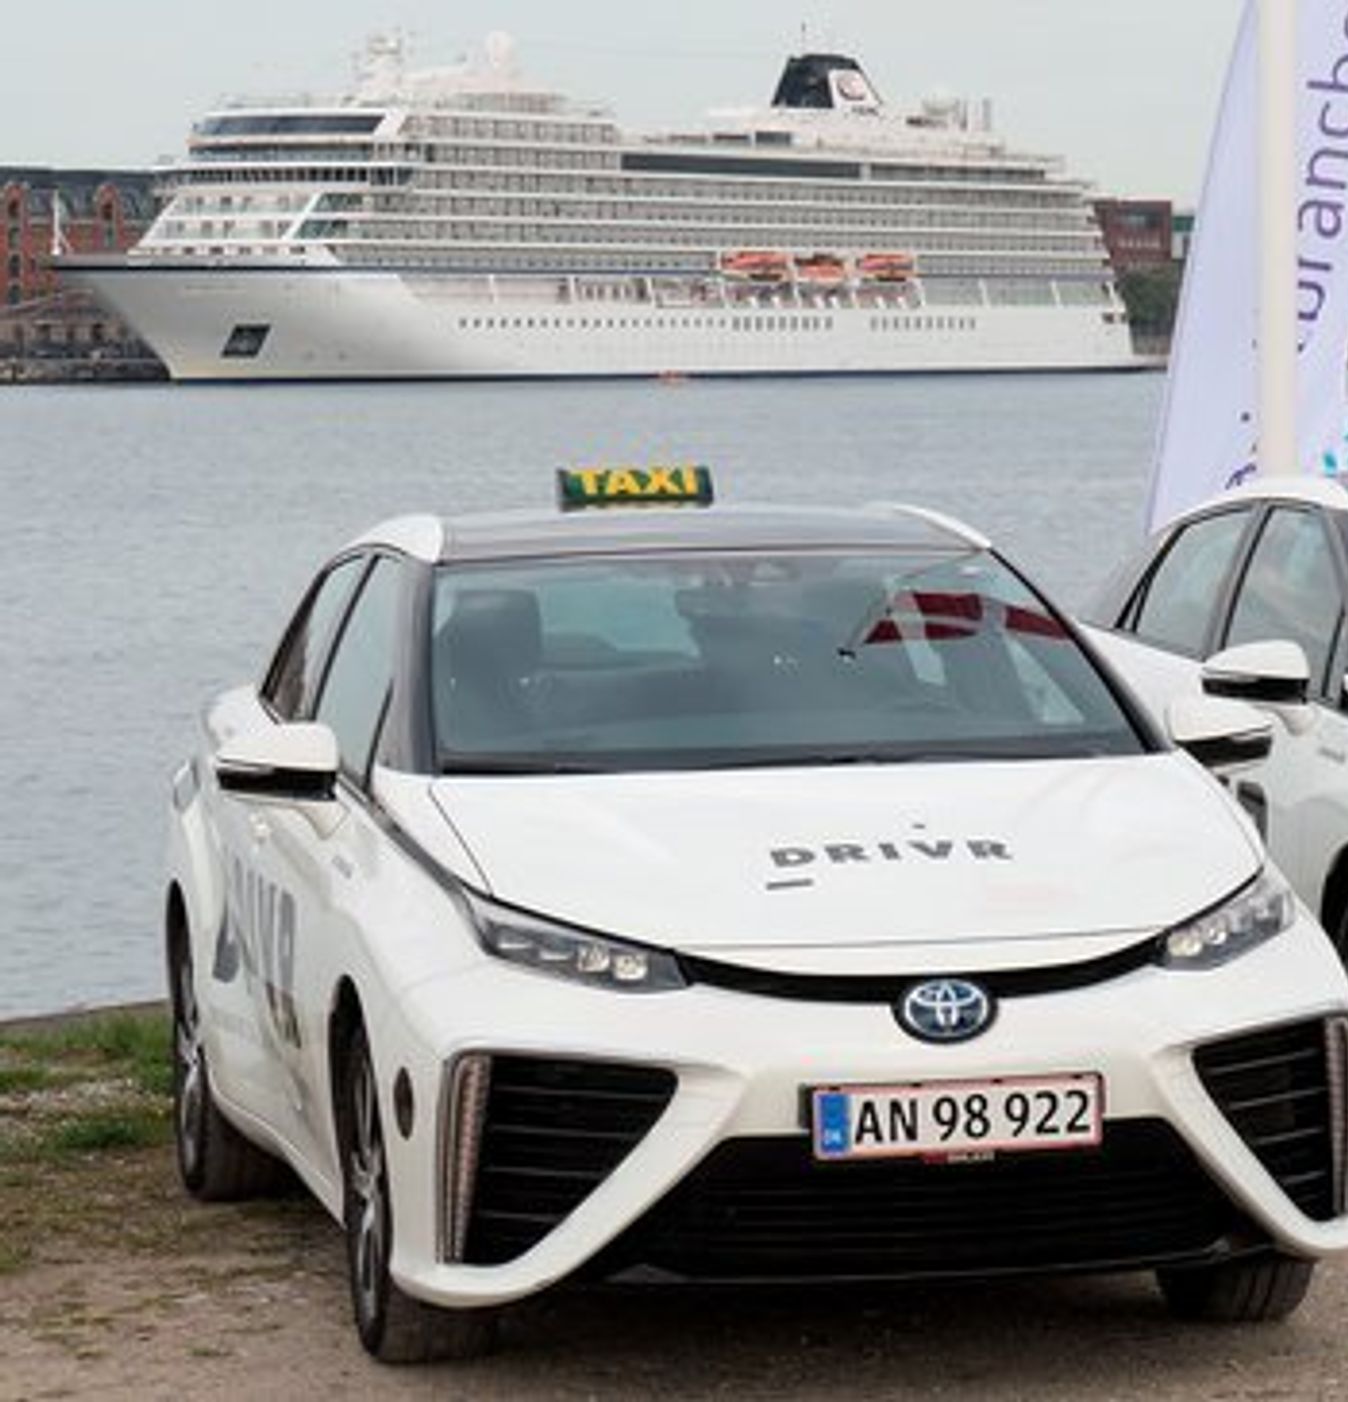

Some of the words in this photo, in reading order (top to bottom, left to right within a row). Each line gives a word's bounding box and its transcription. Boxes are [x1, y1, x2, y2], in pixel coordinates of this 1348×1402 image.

[570, 466, 699, 495] TAXI
[768, 822, 1013, 868] DRIVR
[855, 1098, 919, 1145] AN
[932, 1093, 991, 1142] 98
[1004, 1089, 1091, 1138] 922
